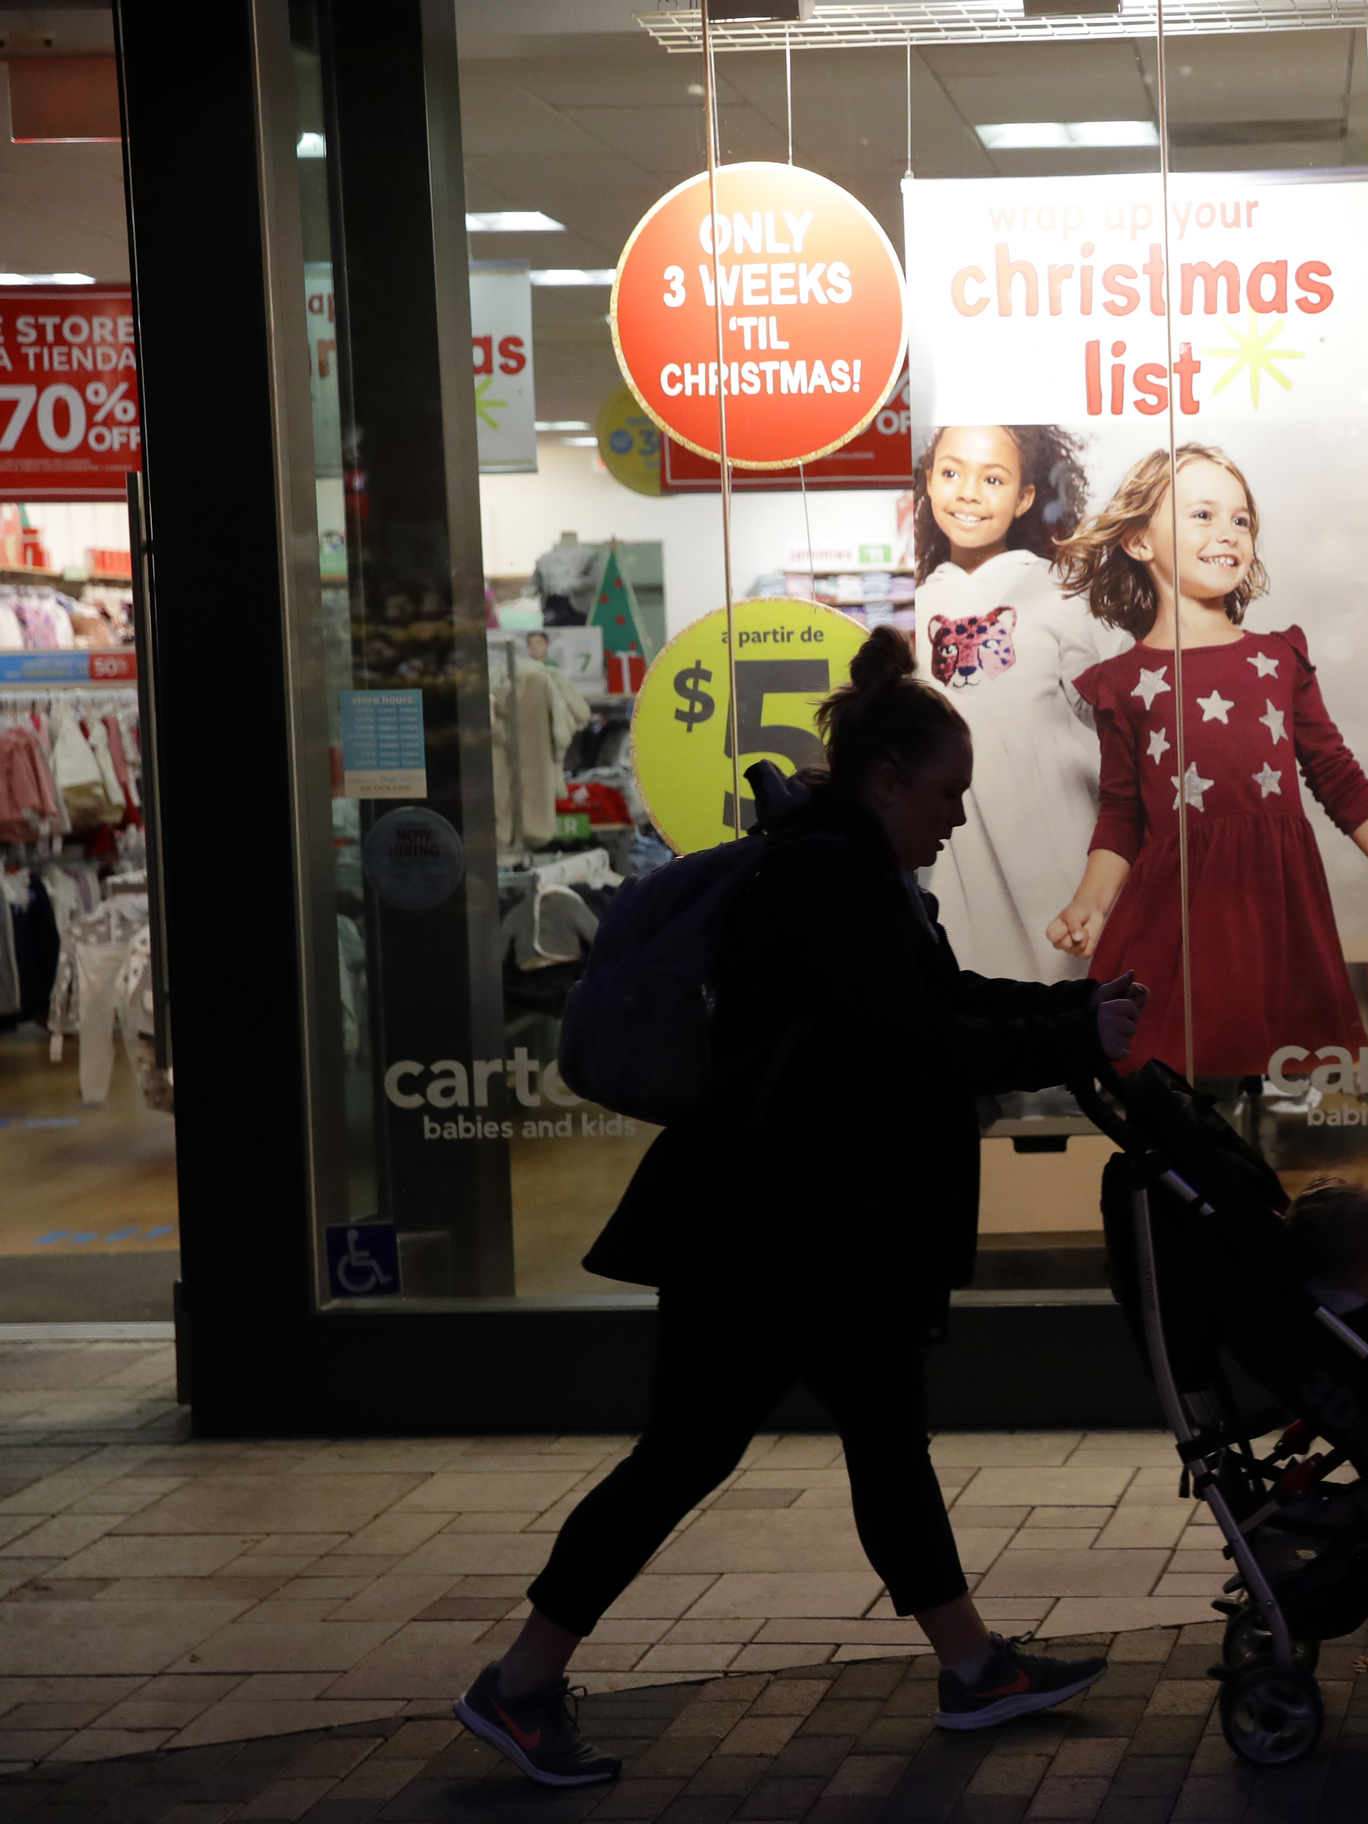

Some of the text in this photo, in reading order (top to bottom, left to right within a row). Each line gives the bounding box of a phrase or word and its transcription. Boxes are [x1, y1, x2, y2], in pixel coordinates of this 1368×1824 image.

[699, 211, 814, 255] ONLY
[988, 199, 1258, 241] wrap up your
[663, 262, 852, 307] 3 WEEKS
[951, 242, 1334, 317] christmas
[16, 316, 134, 343] STORE
[729, 316, 789, 350] 'TIL
[21, 345, 136, 371] TIENDA
[660, 359, 861, 396] CHRISTMAS!
[1085, 340, 1200, 415] list
[875, 409, 911, 436] OF
[87, 425, 140, 452] OFF
[739, 626, 795, 647] partir
[800, 626, 824, 643] de
[351, 694, 413, 705] store hours
[396, 829, 432, 842] NOW
[388, 844, 440, 857] HIRING
[423, 1113, 638, 1139] babies and kids
